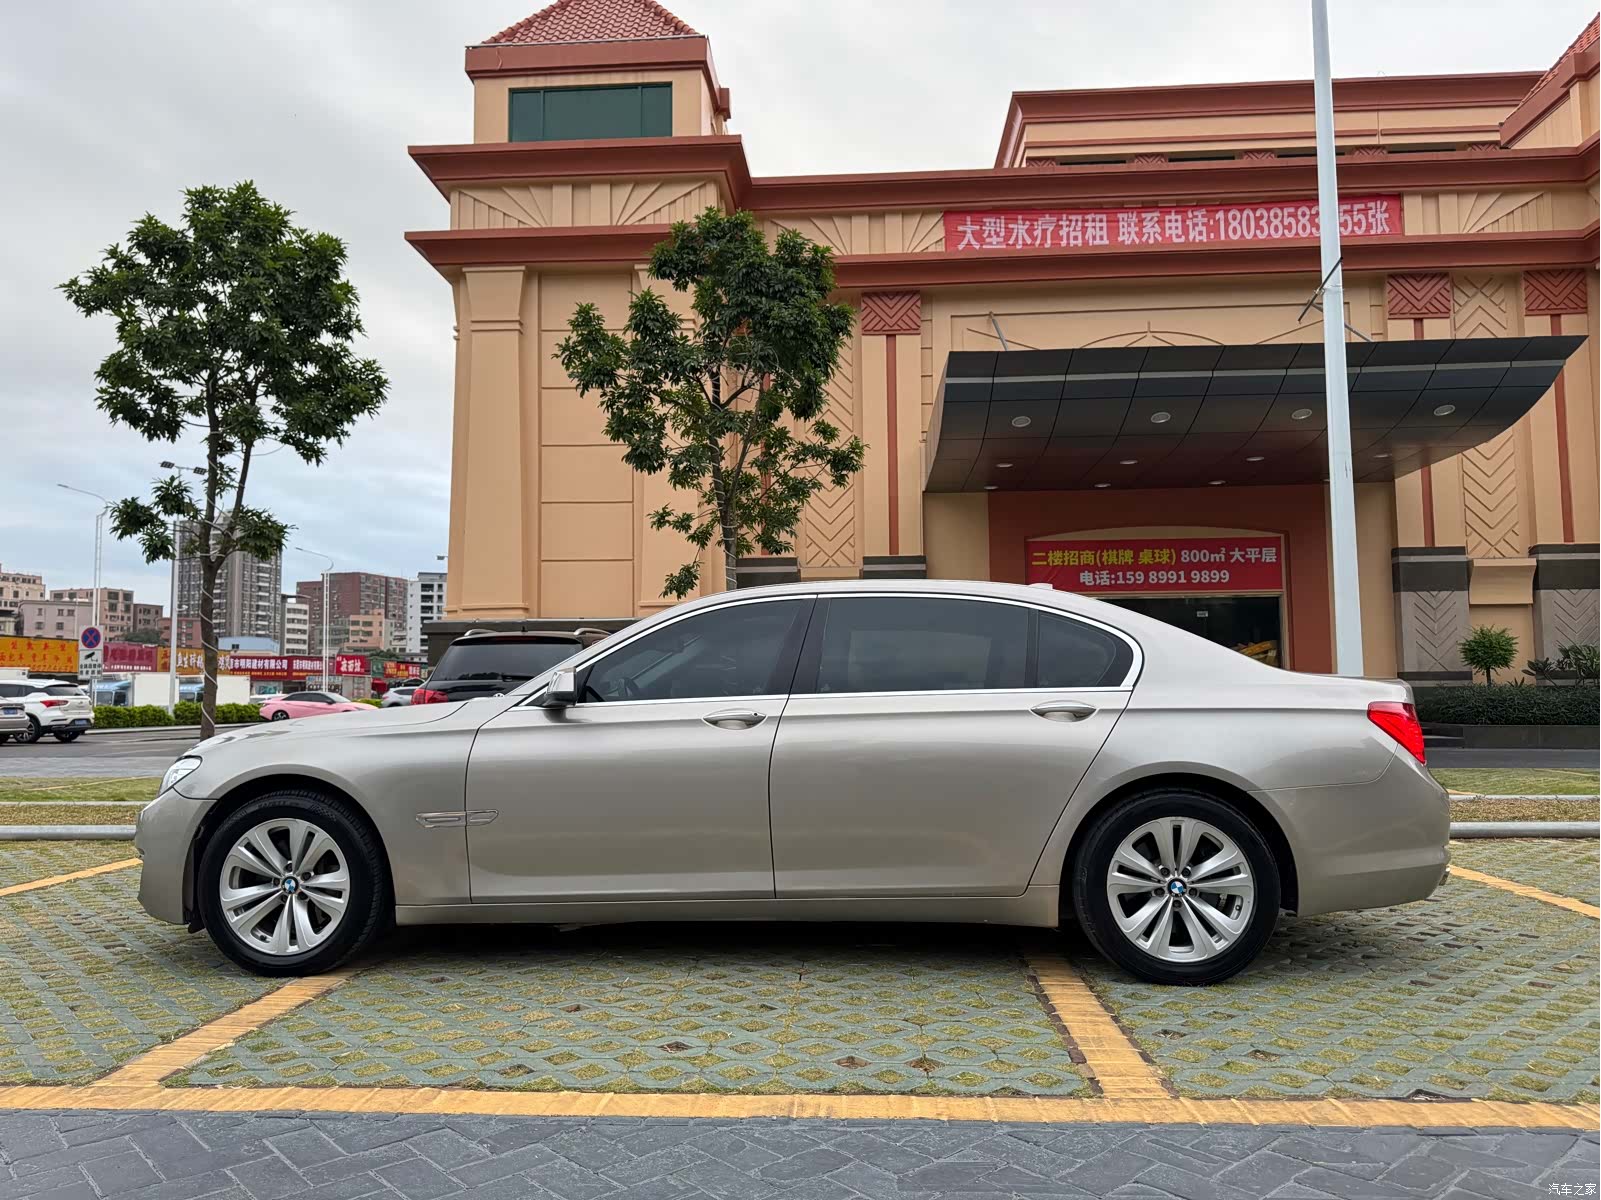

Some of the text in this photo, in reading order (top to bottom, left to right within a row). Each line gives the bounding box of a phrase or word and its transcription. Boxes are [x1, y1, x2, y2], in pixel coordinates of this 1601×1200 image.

[957, 201, 1390, 251] 大型水疗招租 联系电话:1803858355张
[1032, 549, 1134, 567] 二楼招商(棋牌
[1138, 548, 1177, 565] 桌球)
[1230, 547, 1277, 563] 大平层
[1079, 569, 1230, 586] 电话:159 8991 9899
